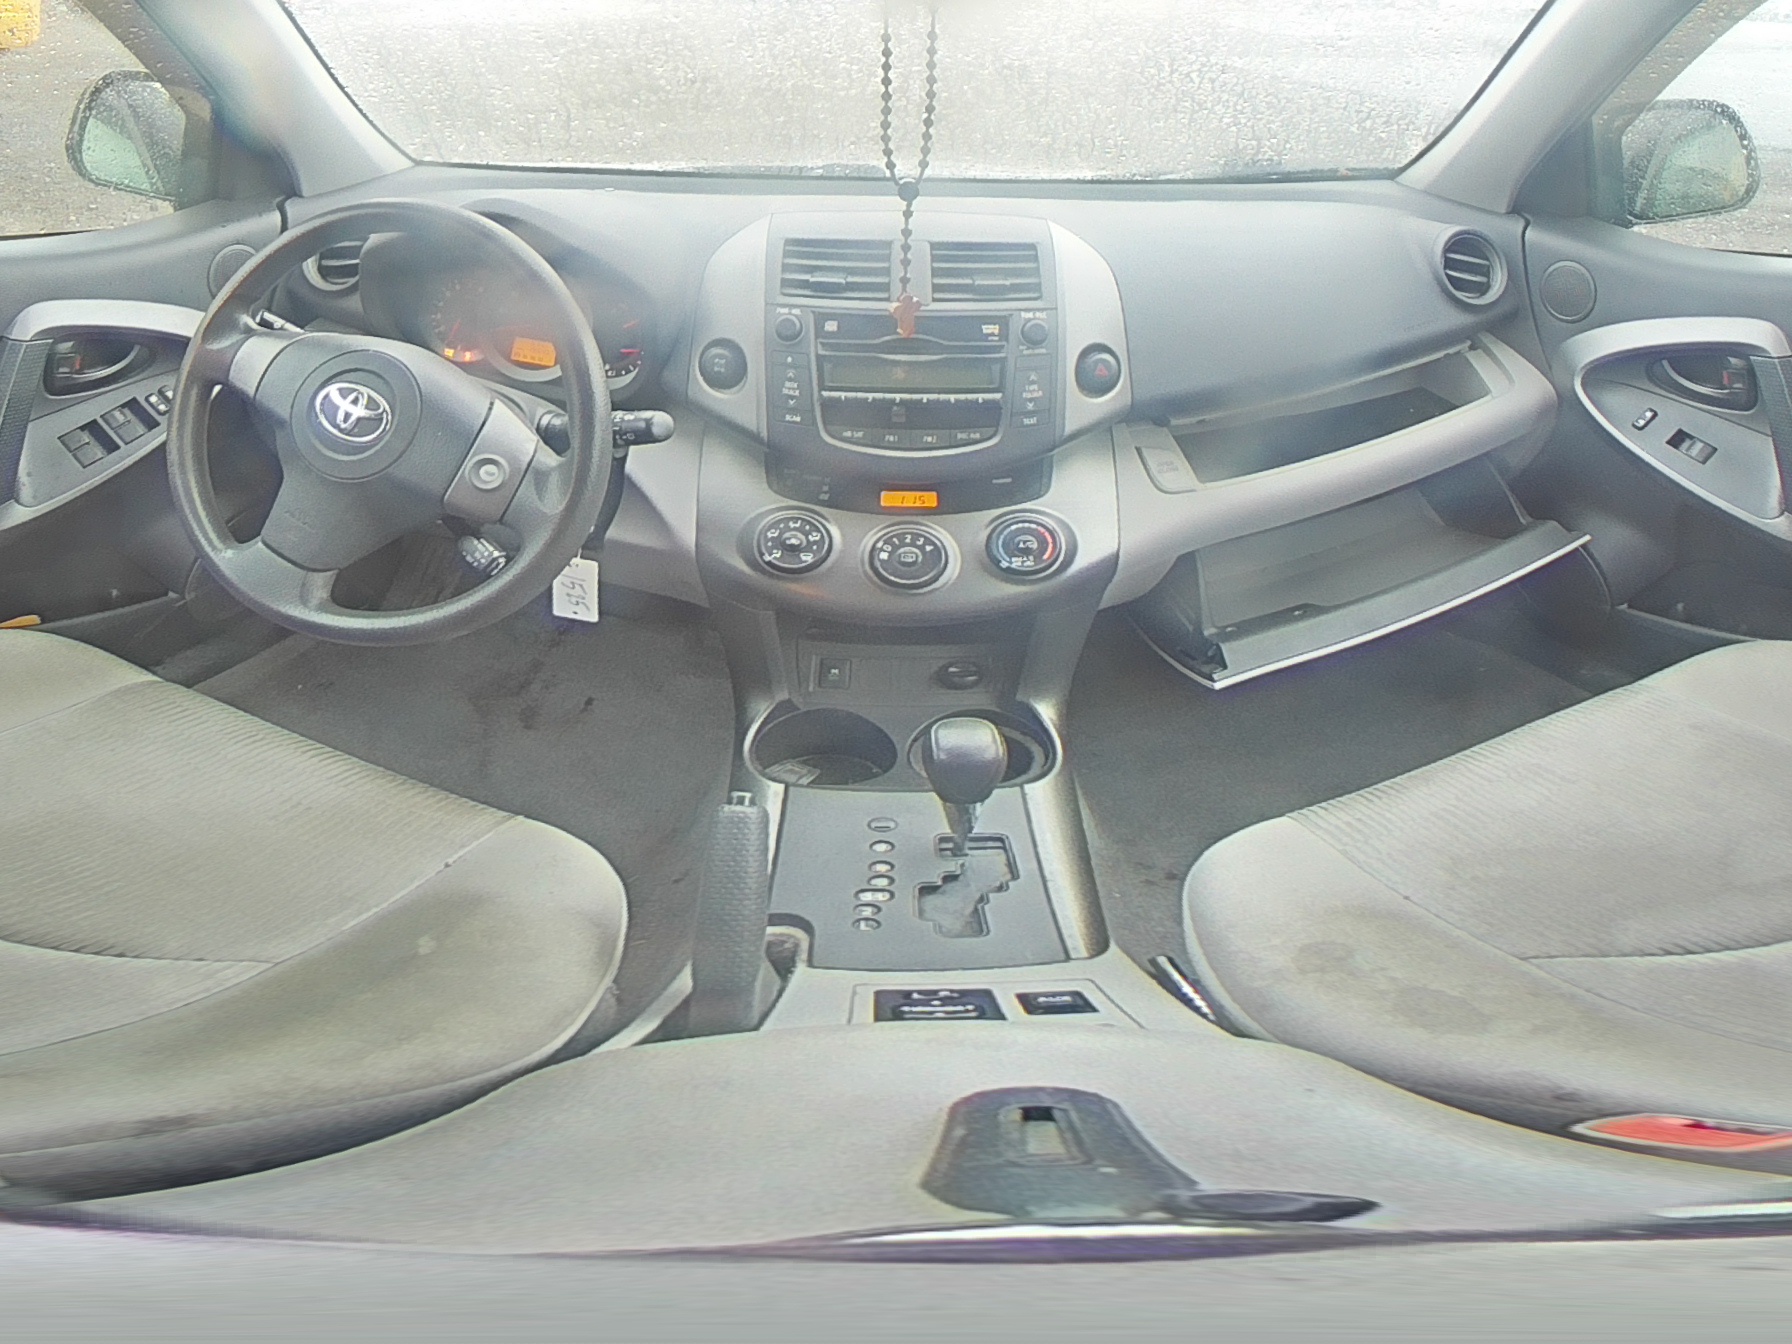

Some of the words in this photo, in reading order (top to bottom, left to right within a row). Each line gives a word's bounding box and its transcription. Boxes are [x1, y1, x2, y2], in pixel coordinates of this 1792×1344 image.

[892, 537, 900, 545] 1
[904, 534, 912, 544] 2
[915, 537, 925, 545] 3
